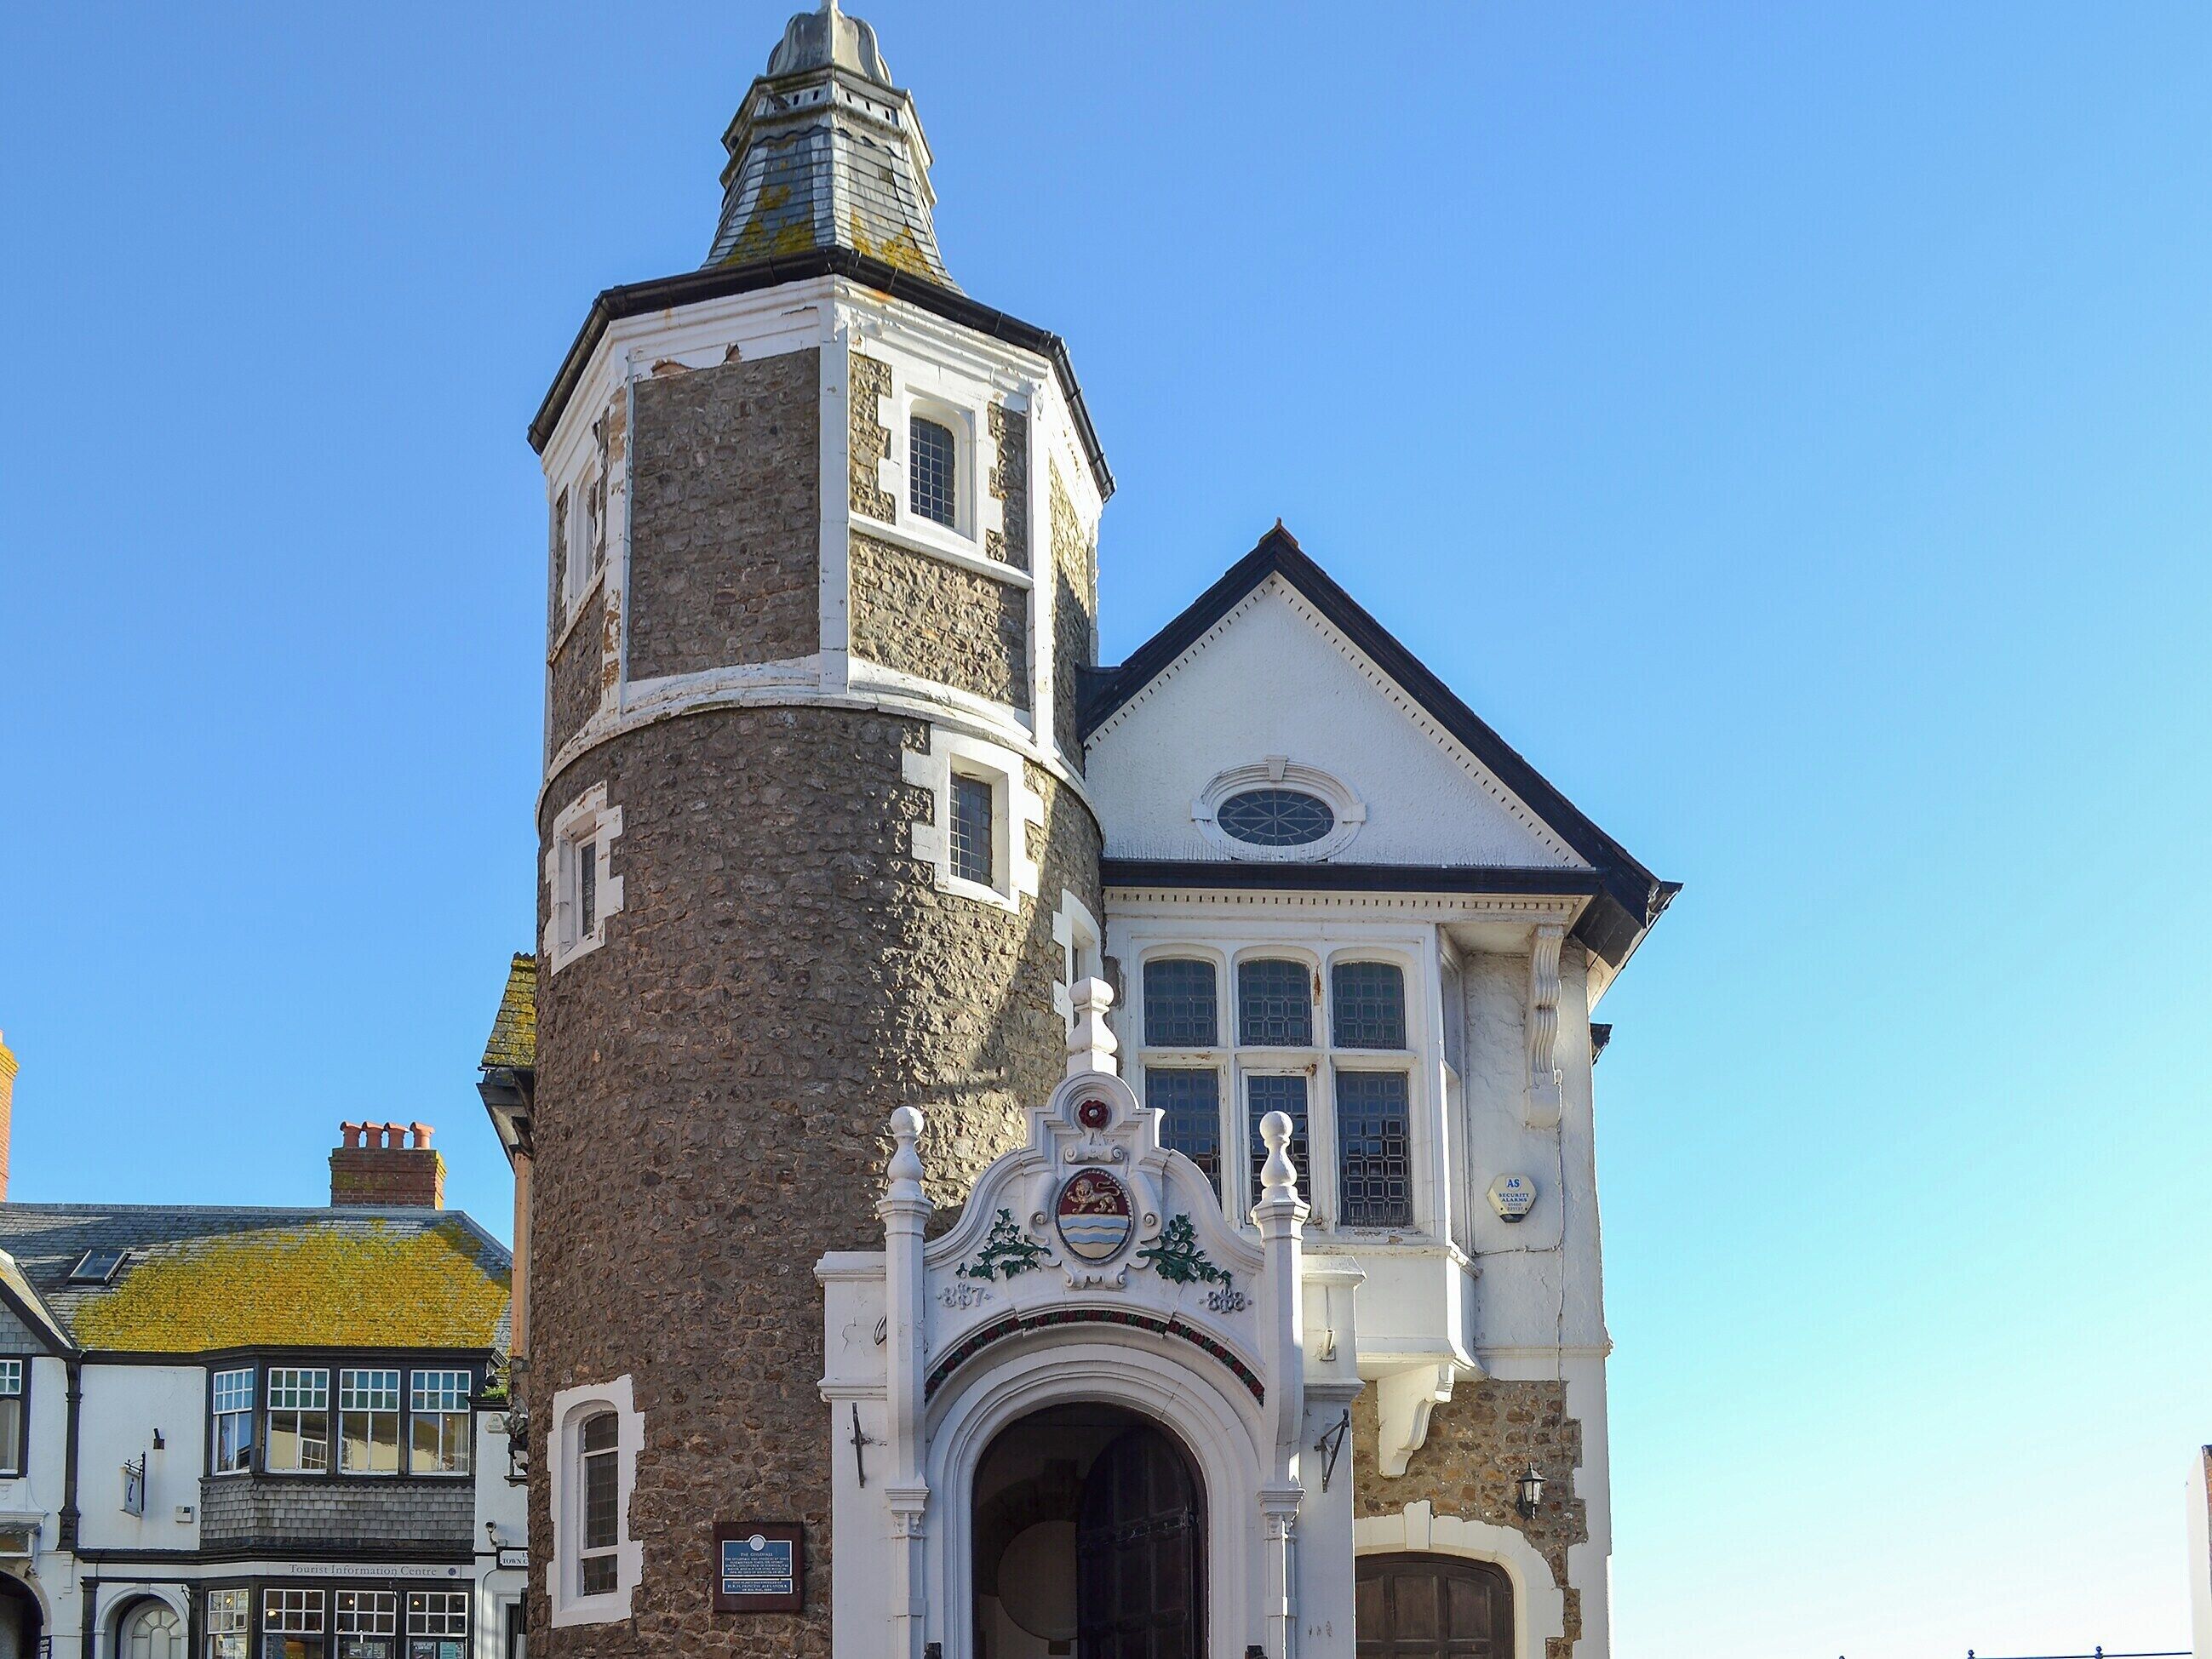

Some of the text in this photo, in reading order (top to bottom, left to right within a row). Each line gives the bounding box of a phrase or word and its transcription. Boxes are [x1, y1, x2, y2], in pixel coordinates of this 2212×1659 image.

[1507, 1178, 1520, 1188] AS
[289, 1564, 437, 1576] Tourist Information Centre
